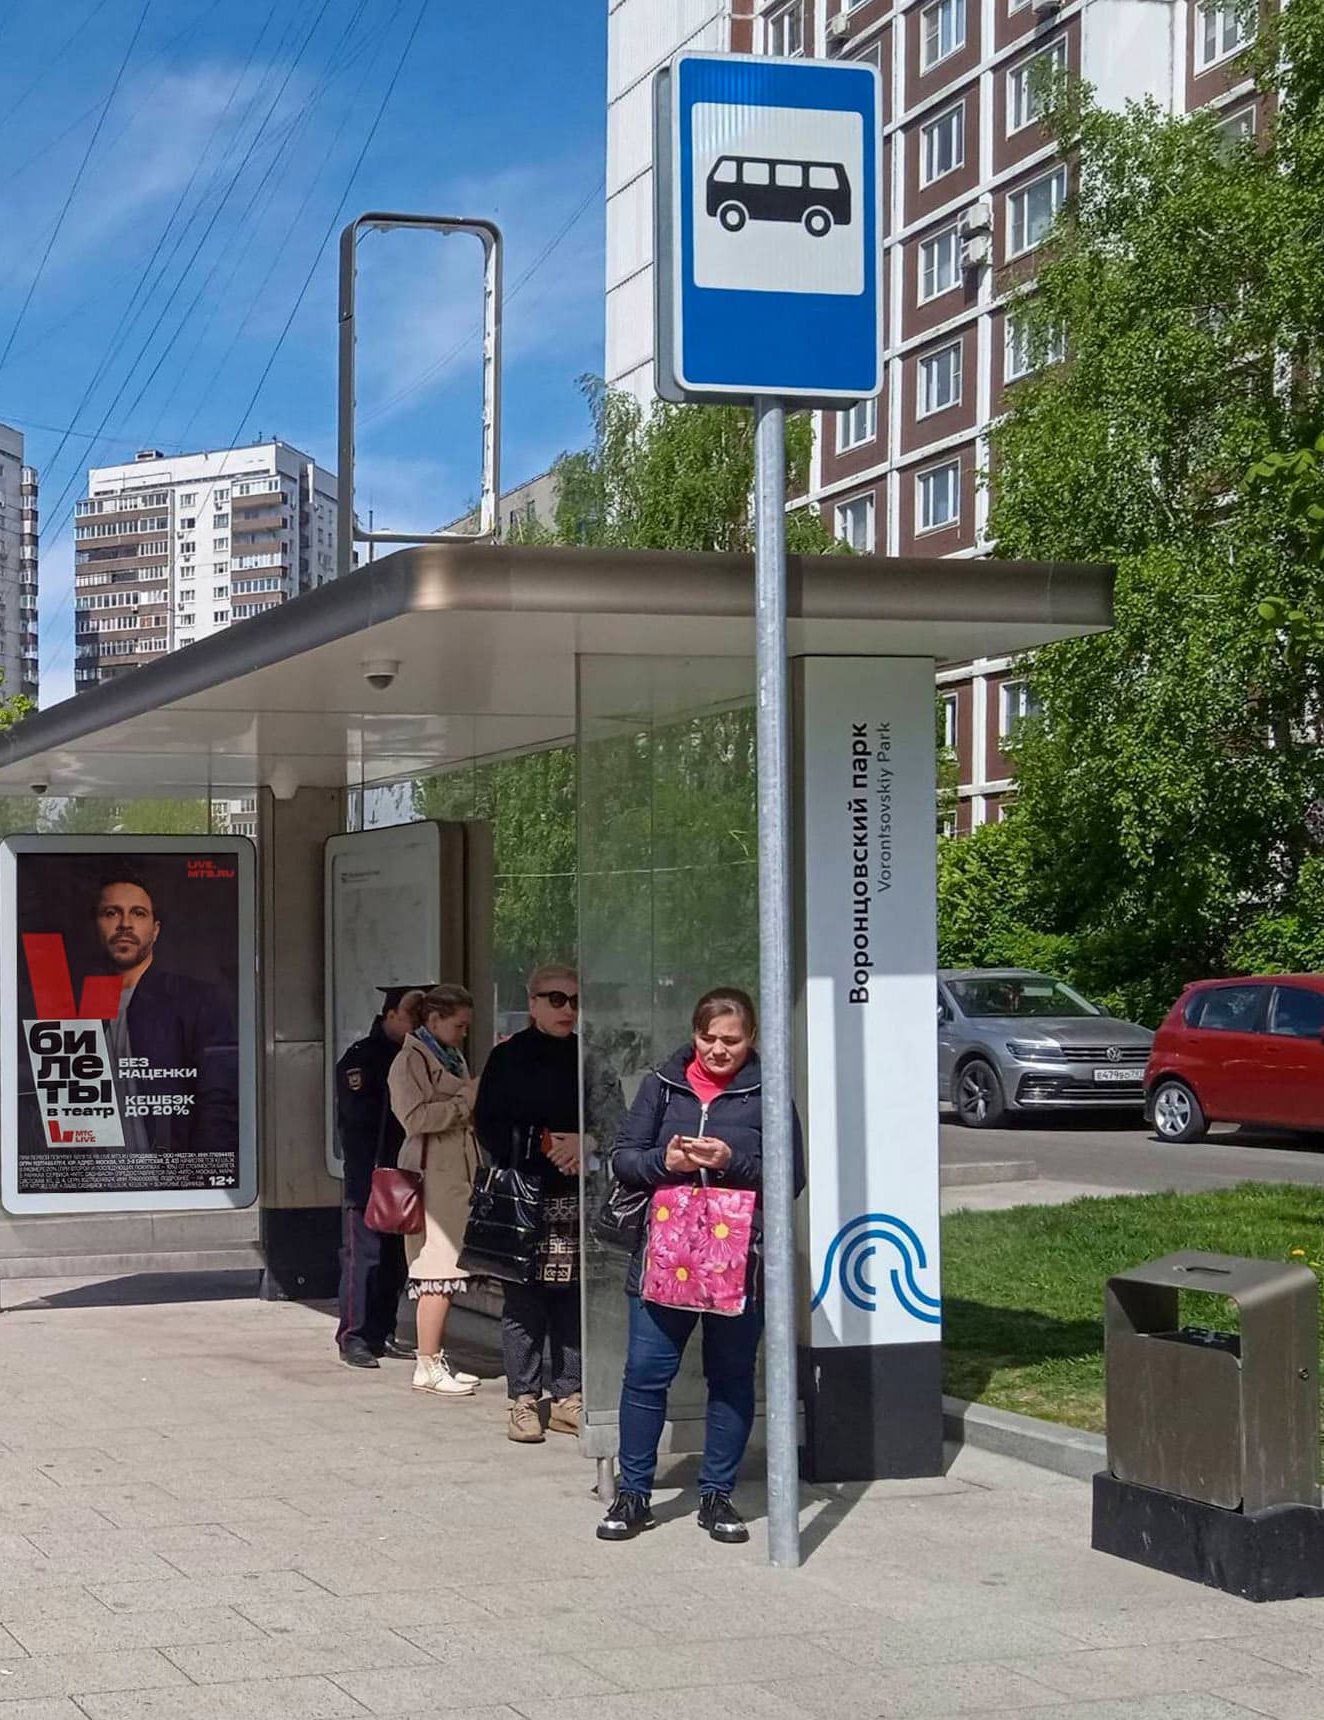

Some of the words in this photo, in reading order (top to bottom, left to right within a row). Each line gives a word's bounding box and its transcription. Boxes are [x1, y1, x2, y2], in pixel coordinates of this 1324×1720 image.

[876, 721, 891, 763] Park
[852, 722, 872, 789] парк
[876, 767, 895, 893] Vorontsovskiy
[847, 799, 874, 1004] Воронцовский
[29, 1021, 97, 1055] би
[37, 1055, 104, 1080] ле
[118, 1057, 149, 1068] БЕЗ
[118, 1067, 198, 1081] НАЦЕНКИ
[37, 1080, 112, 1104] ты
[125, 1094, 195, 1106] КЕШБЭК
[47, 1108, 58, 1117] в
[62, 1107, 115, 1119] театр
[125, 1106, 149, 1118] ДО
[152, 1104, 190, 1116] 20%
[208, 1175, 236, 1187] 12+
